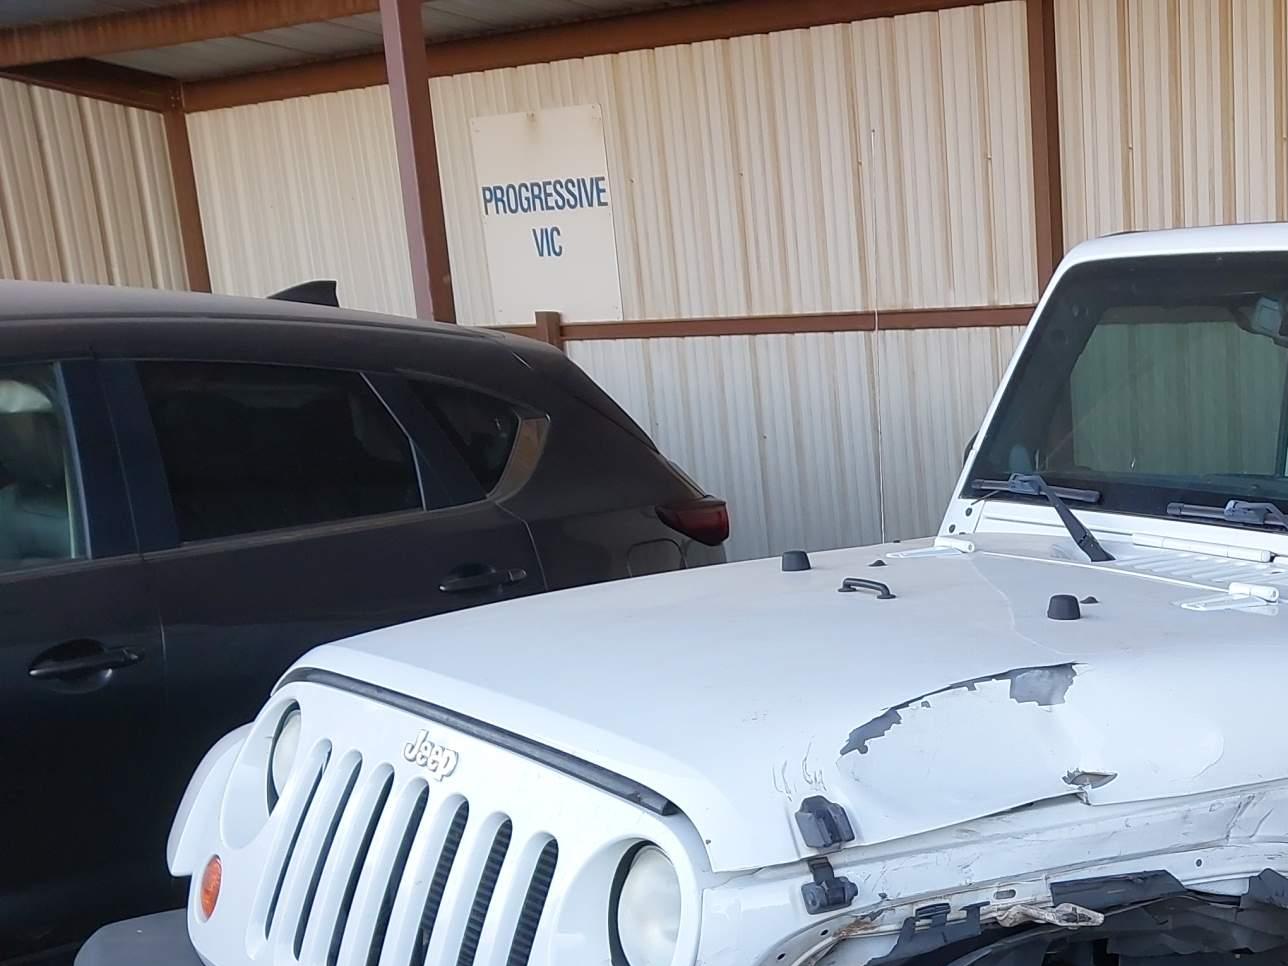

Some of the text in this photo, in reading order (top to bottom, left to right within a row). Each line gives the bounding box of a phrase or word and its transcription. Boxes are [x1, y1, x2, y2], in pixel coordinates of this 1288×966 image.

[481, 176, 609, 216] PROGRESSIVE
[532, 226, 563, 257] VIC
[404, 728, 459, 782] Jeep
